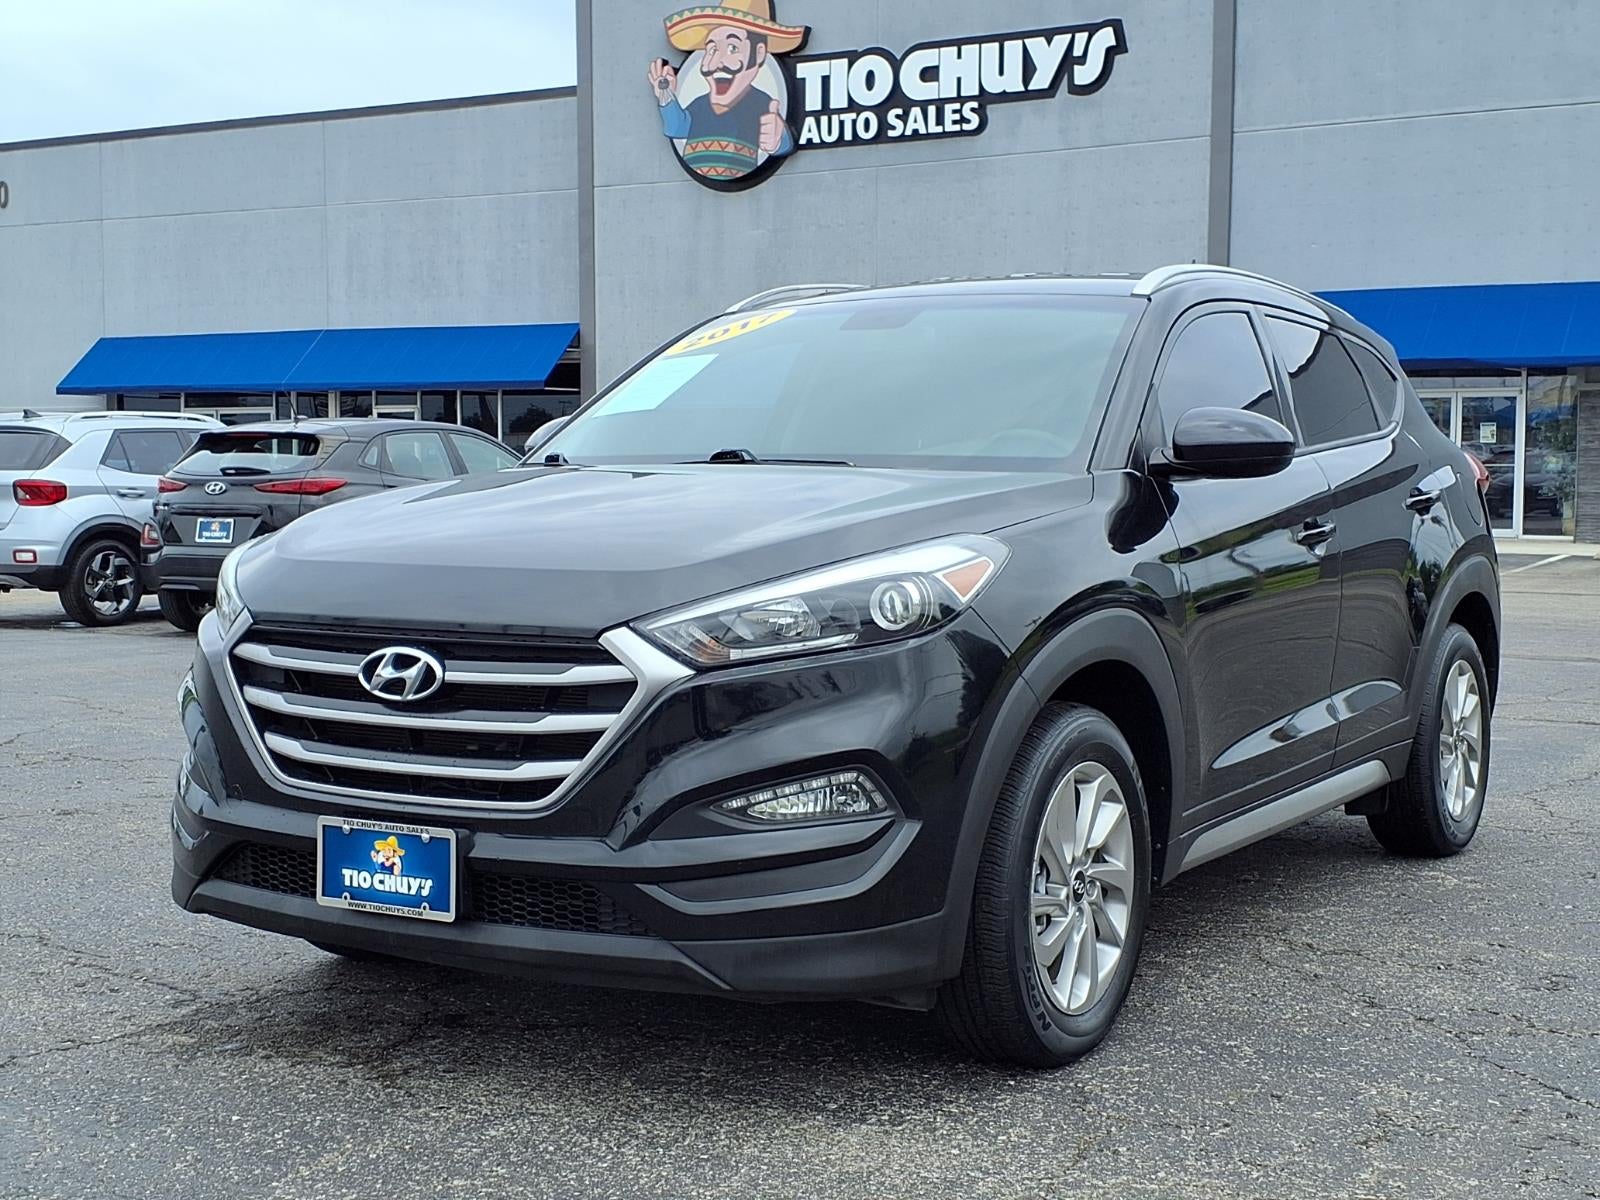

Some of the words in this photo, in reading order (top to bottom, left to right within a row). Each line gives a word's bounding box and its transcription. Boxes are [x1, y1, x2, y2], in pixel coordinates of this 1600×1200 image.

[797, 55, 893, 112] TIO
[899, 26, 1116, 101] CHUY'S
[799, 110, 878, 145] AUTO
[887, 101, 979, 138] SALES
[682, 311, 779, 350] 2017
[342, 819, 354, 827] TIO
[356, 821, 383, 830] CHUY'S
[384, 824, 404, 832] AUTO
[406, 826, 430, 834] SALES
[341, 868, 371, 889] TIO
[372, 873, 433, 897] CHUY'S
[347, 901, 424, 918] WWW.TIOCHUYS.COM
